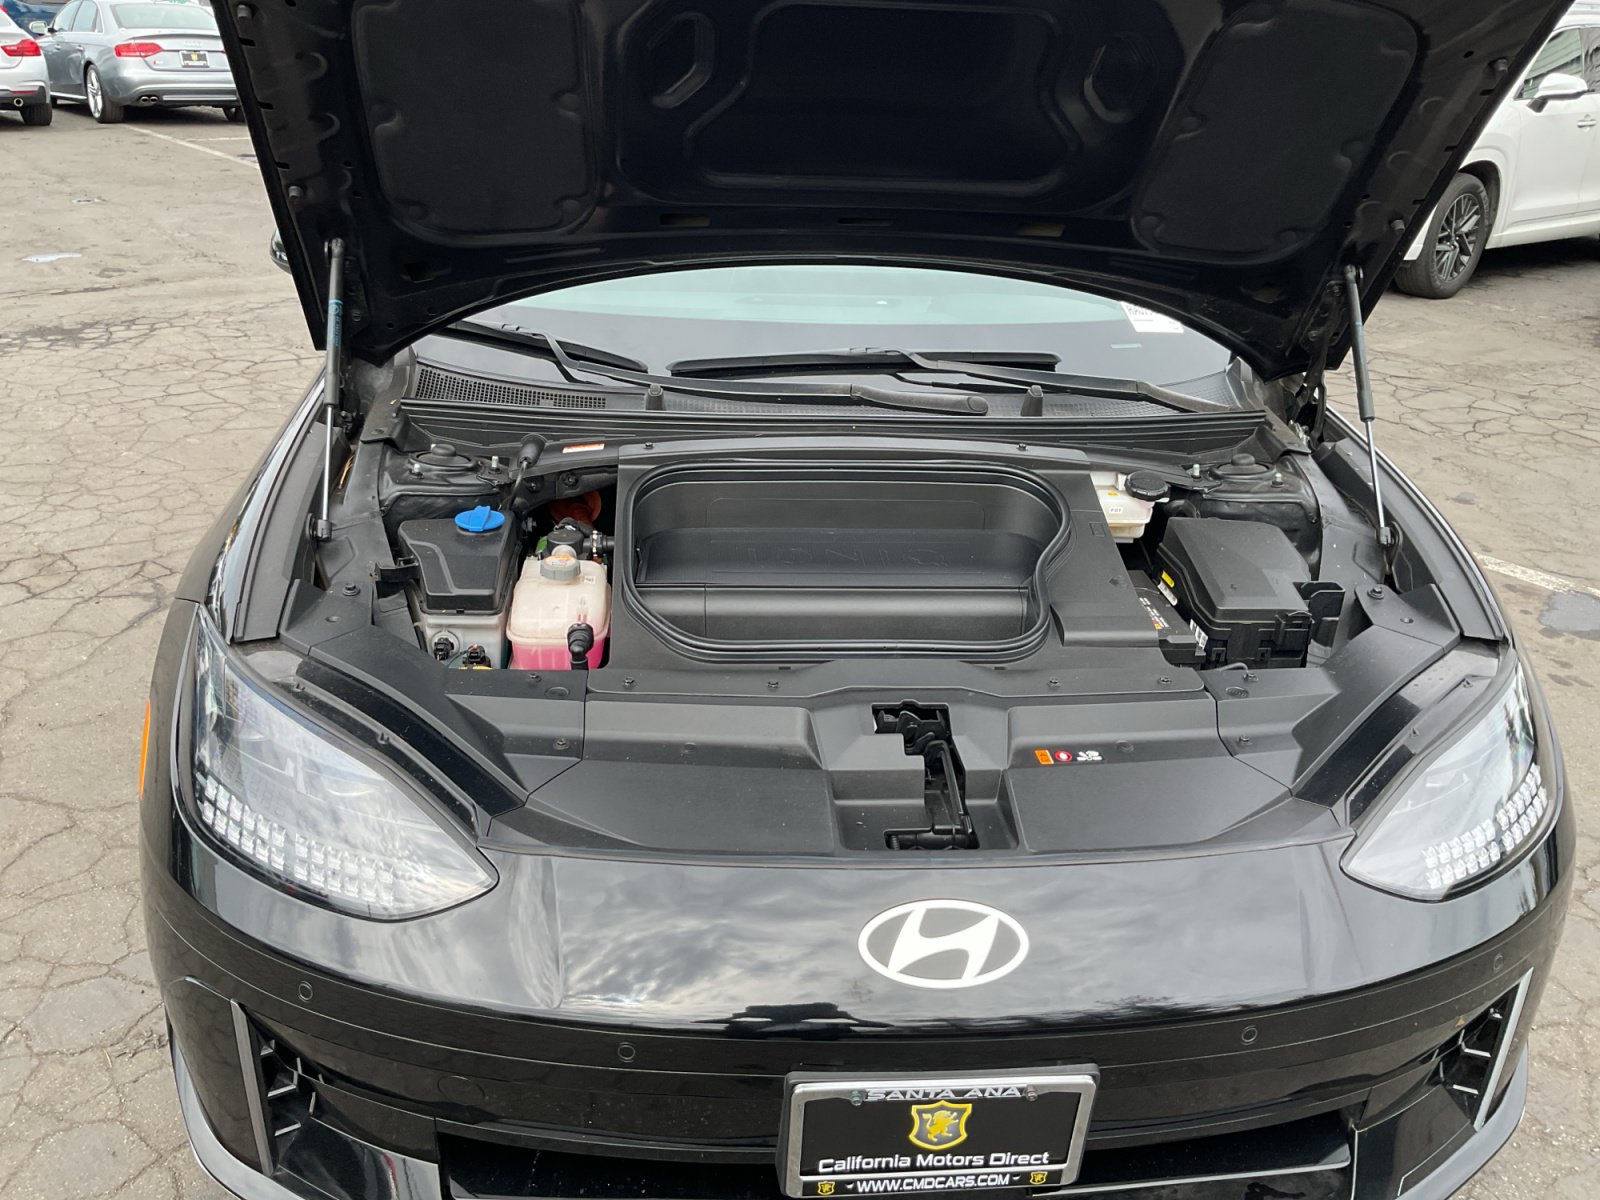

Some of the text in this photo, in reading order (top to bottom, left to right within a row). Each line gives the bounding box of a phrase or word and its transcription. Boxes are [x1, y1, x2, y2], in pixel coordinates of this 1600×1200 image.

[867, 1086, 1023, 1100] SANTA ANA
[818, 1151, 1050, 1173] California Motors Direct
[856, 1173, 1010, 1193] WWW.CMDCARS.COM
